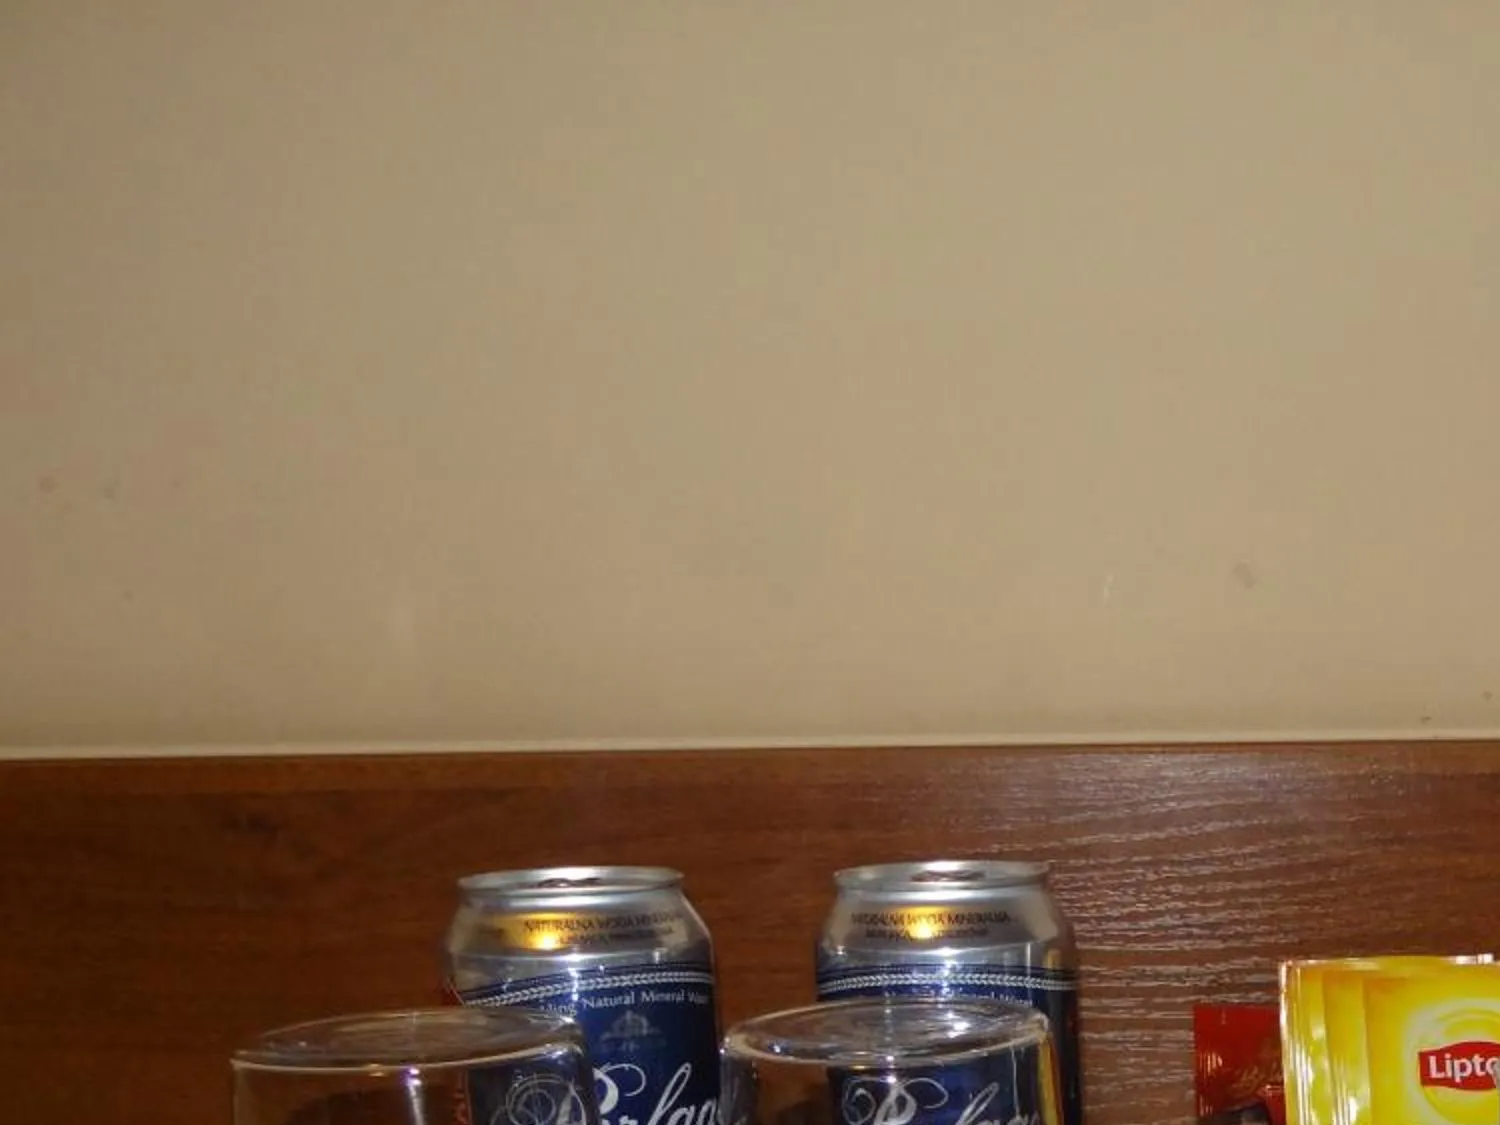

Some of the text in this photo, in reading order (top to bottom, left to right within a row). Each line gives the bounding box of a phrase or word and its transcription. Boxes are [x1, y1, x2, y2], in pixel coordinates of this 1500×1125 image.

[583, 991, 636, 1009] Natural
[641, 989, 684, 1005] Mineral
[1428, 1052, 1499, 1084] Lipto
